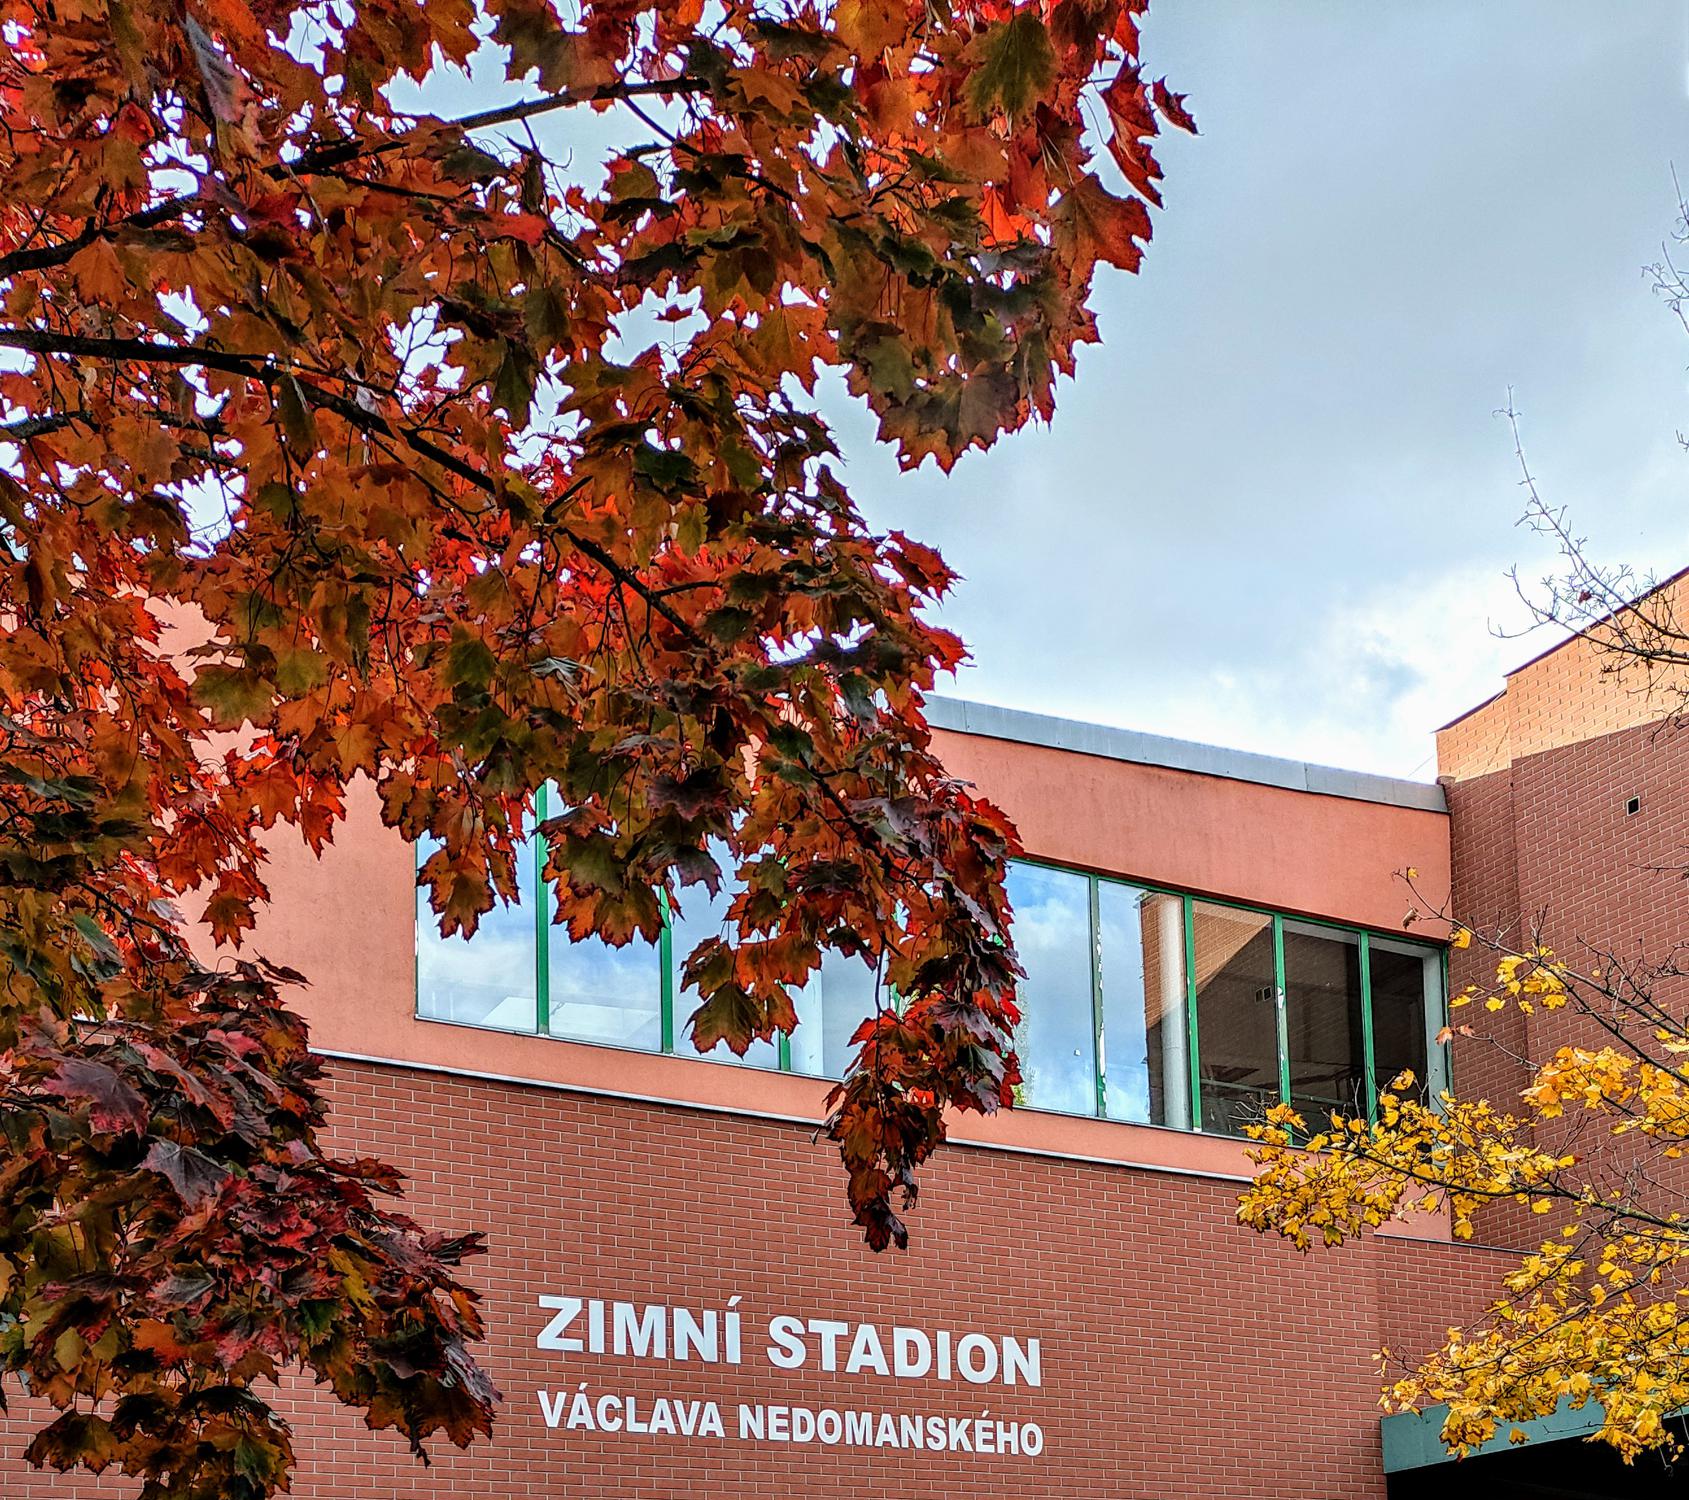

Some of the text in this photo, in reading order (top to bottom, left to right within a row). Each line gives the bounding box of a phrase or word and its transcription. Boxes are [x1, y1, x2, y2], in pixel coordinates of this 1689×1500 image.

[536, 1294, 1042, 1388] ZIMNÍ STADION
[536, 1382, 1044, 1457] VÁCLAVA NEDOMANSKÉHO
